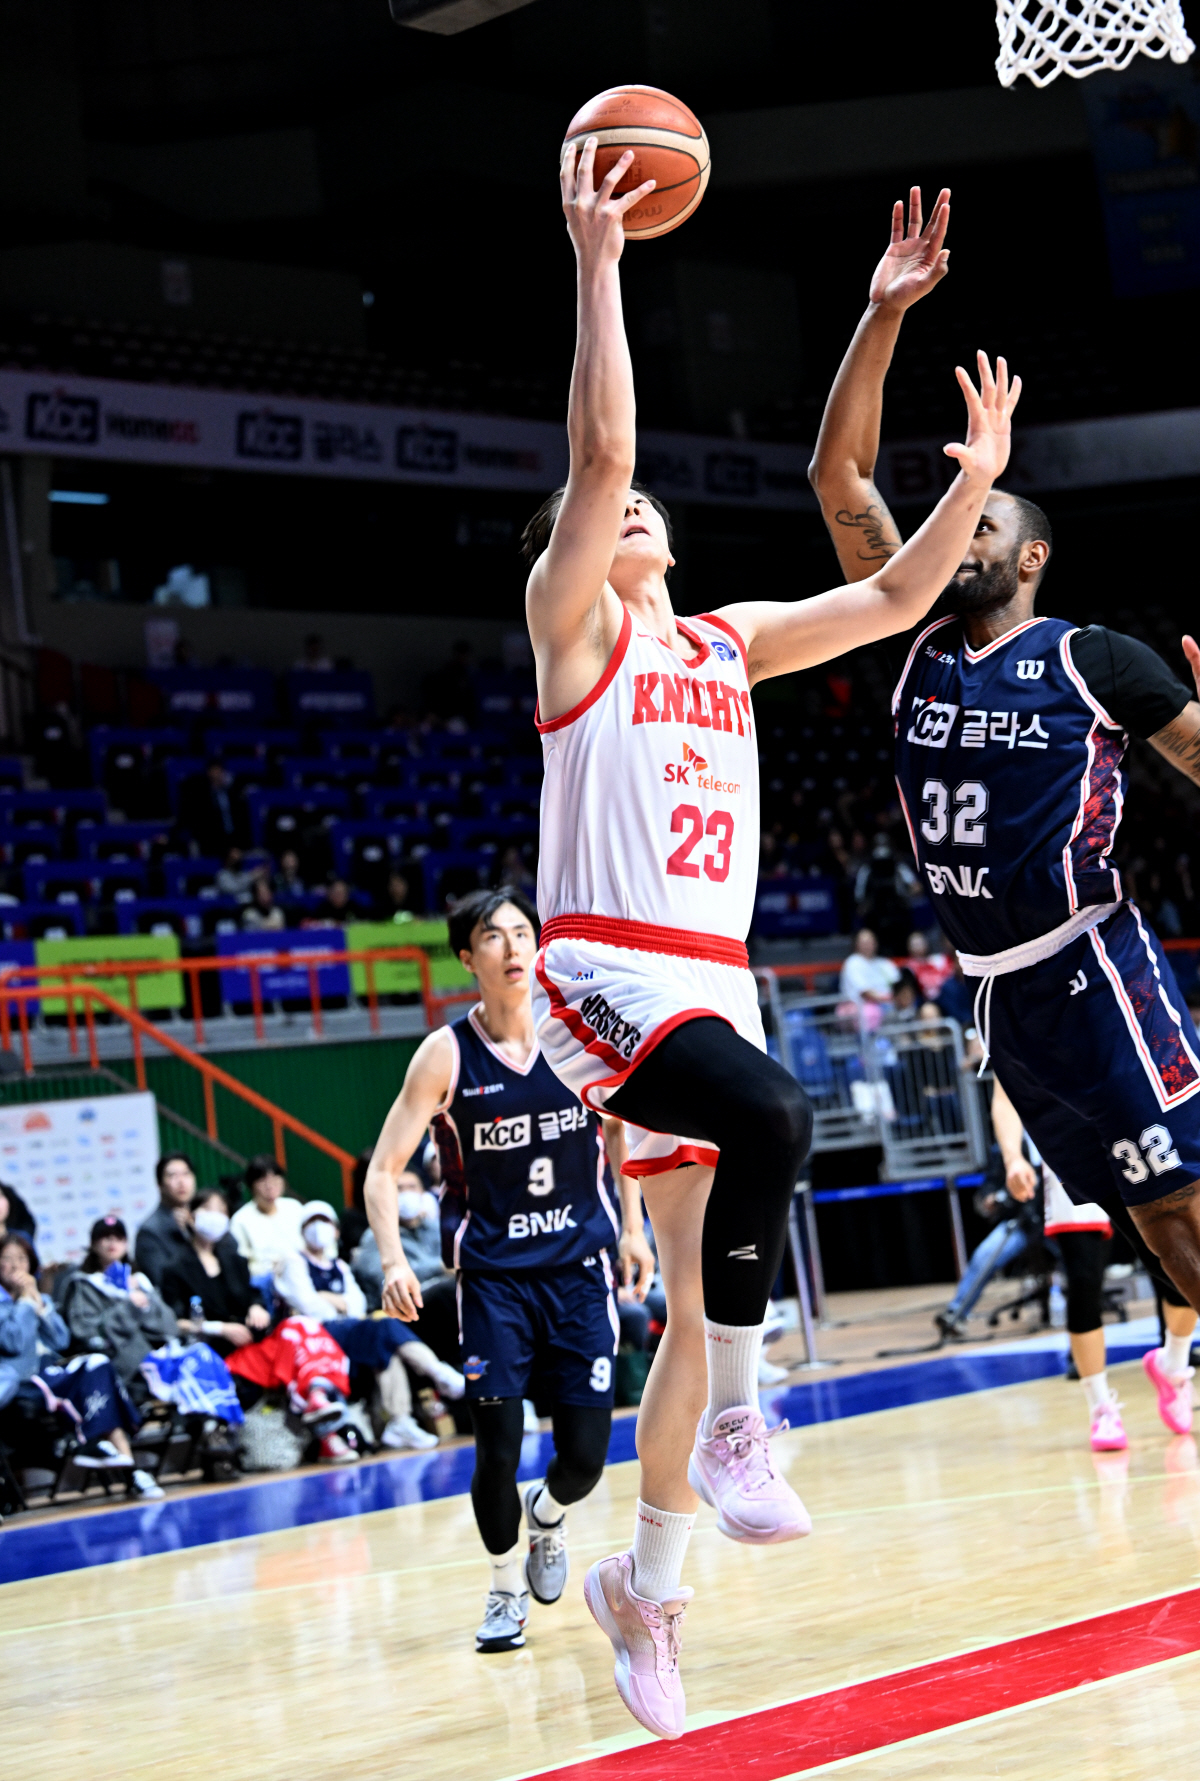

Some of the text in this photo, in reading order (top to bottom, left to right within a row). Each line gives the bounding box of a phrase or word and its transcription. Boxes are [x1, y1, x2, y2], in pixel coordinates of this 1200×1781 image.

[960, 709, 1050, 750] 글라스
[663, 763, 690, 786] SK
[920, 778, 990, 848] 32
[666, 803, 735, 883] 23
[477, 1115, 529, 1149] KCC
[1111, 1123, 1184, 1185] 32
[527, 1156, 555, 1197] 9
[508, 1203, 578, 1240] BNK
[589, 1355, 612, 1393] 9
